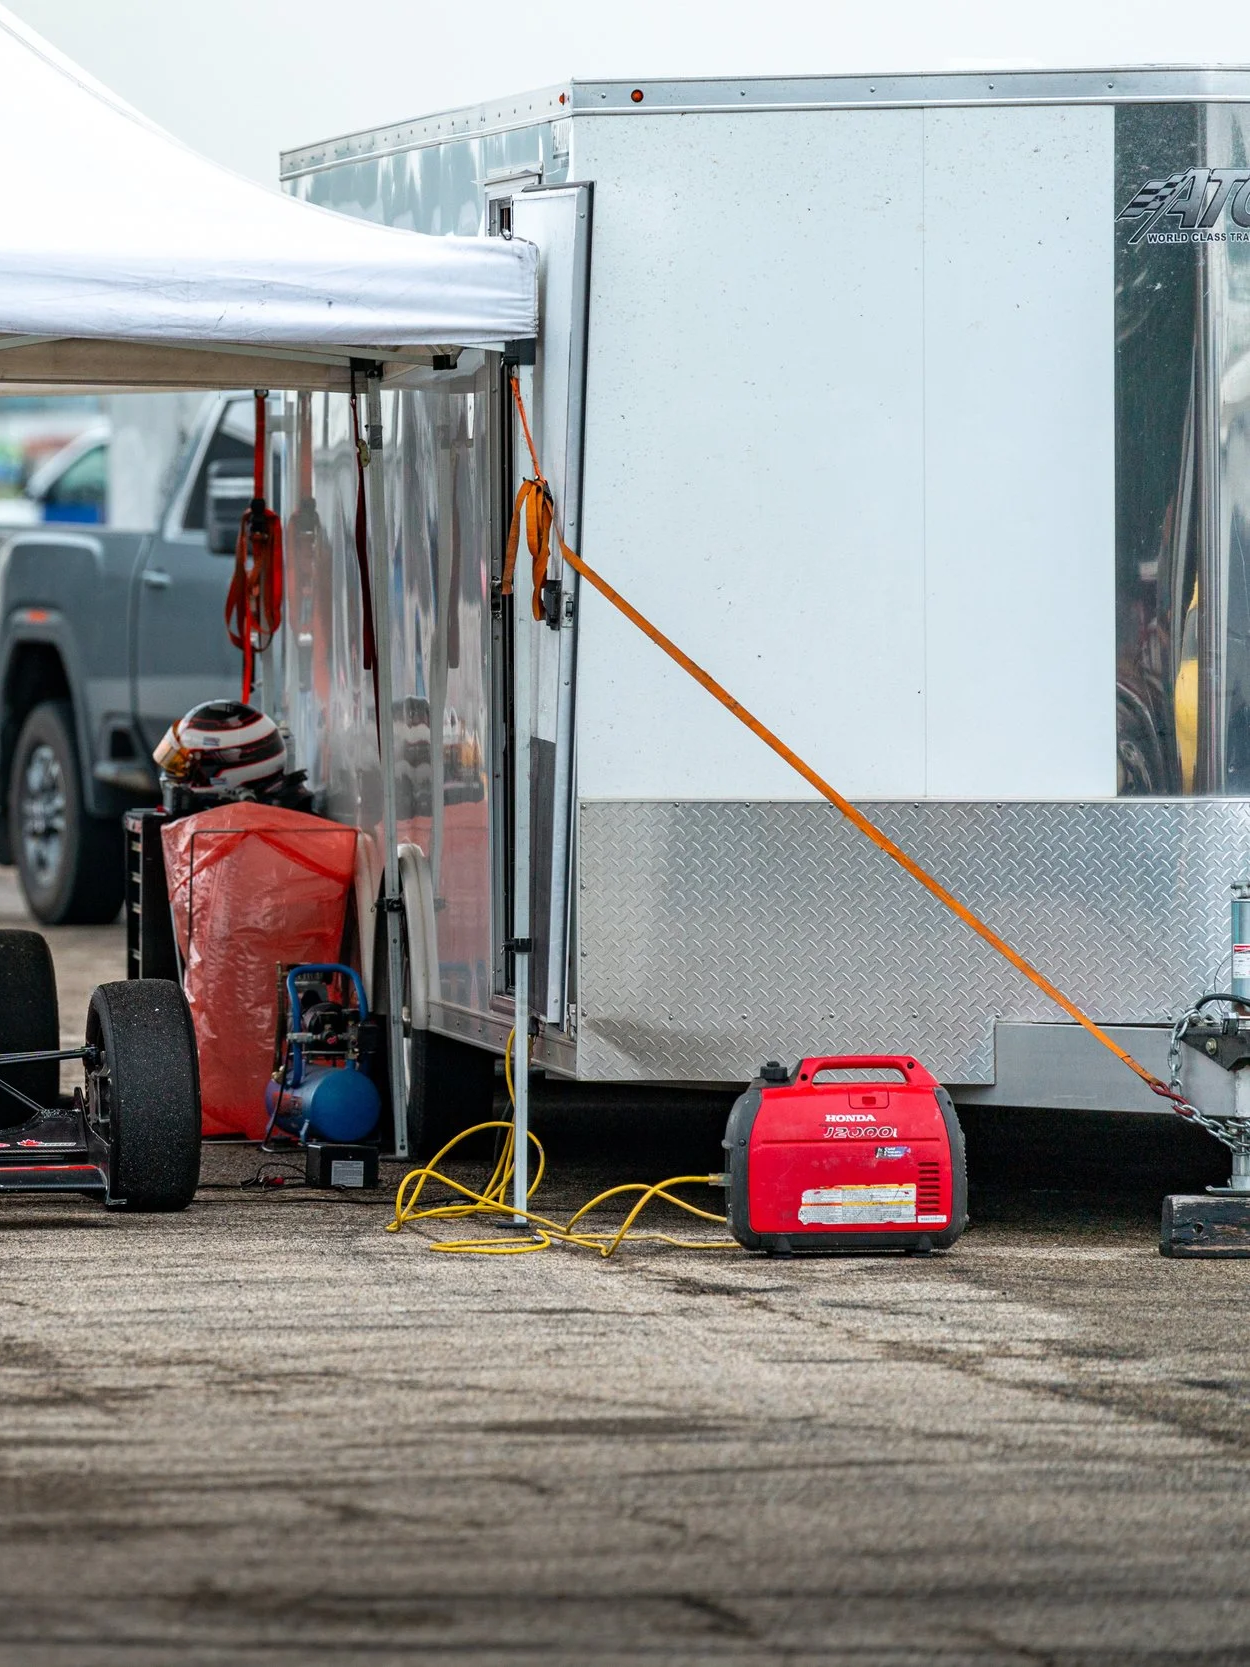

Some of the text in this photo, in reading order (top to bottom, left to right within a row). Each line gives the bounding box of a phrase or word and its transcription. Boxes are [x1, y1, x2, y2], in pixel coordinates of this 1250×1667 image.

[1147, 232, 1188, 243] WORLD
[1192, 232, 1227, 242] CLASS
[825, 1114, 877, 1122] HONDA
